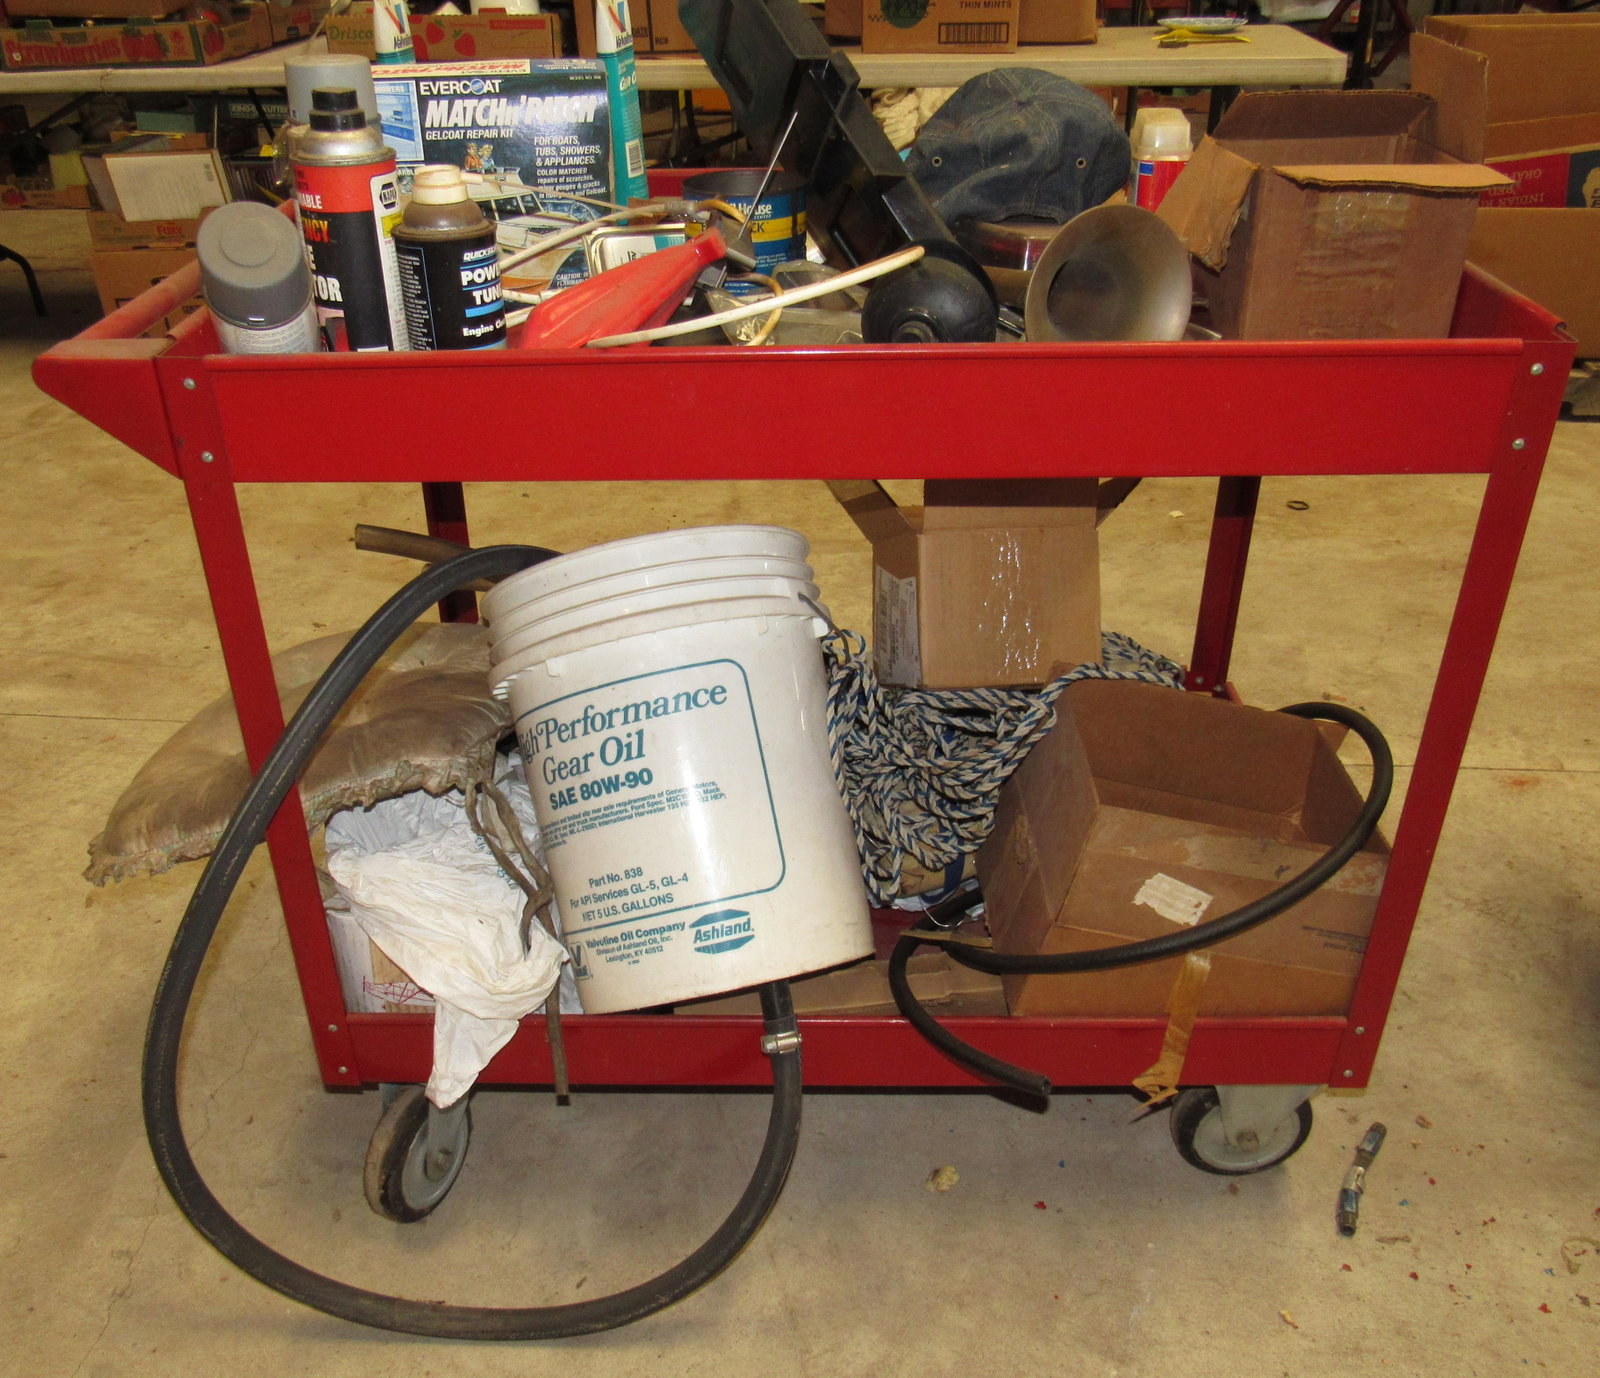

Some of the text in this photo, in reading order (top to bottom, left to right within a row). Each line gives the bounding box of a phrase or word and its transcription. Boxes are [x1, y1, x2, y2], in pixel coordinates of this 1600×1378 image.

[960, 1, 1012, 9] THIN MINTS
[420, 79, 504, 96] EVERCOAT
[425, 128, 514, 141] GELCOAT REPAIR KIT
[534, 135, 580, 146] FOR BOATS,
[535, 145, 602, 156] TUBS, SHOWERS,
[536, 156, 596, 167] & APPLIANCES.
[537, 167, 587, 176] COLOR MATCHED
[303, 218, 331, 243] NCY
[462, 325, 494, 337] Engine
[536, 684, 728, 750] Performance
[543, 728, 646, 785] Gear Oil
[549, 767, 654, 811] SAE 80W-90
[615, 793, 656, 808] requirements
[665, 786, 690, 796] Genera
[631, 802, 646, 811] Ford
[646, 799, 665, 808] Spec.
[703, 787, 721, 795] Mack
[634, 805, 666, 818] Harvester
[589, 866, 643, 888] Part No. 838
[580, 895, 592, 905] API
[592, 887, 629, 904] Services
[630, 880, 660, 894] GL-5,
[660, 872, 689, 887] GL-4
[582, 892, 674, 922] NET 5 U.S. GALLONS
[585, 920, 686, 949] Valvoline Oil Company
[622, 940, 648, 951] Ashland
[648, 937, 660, 946] Oil,
[660, 935, 673, 943] Inc.
[605, 951, 634, 963] Lexington,
[634, 949, 644, 957] KY
[644, 945, 664, 955] 40512
